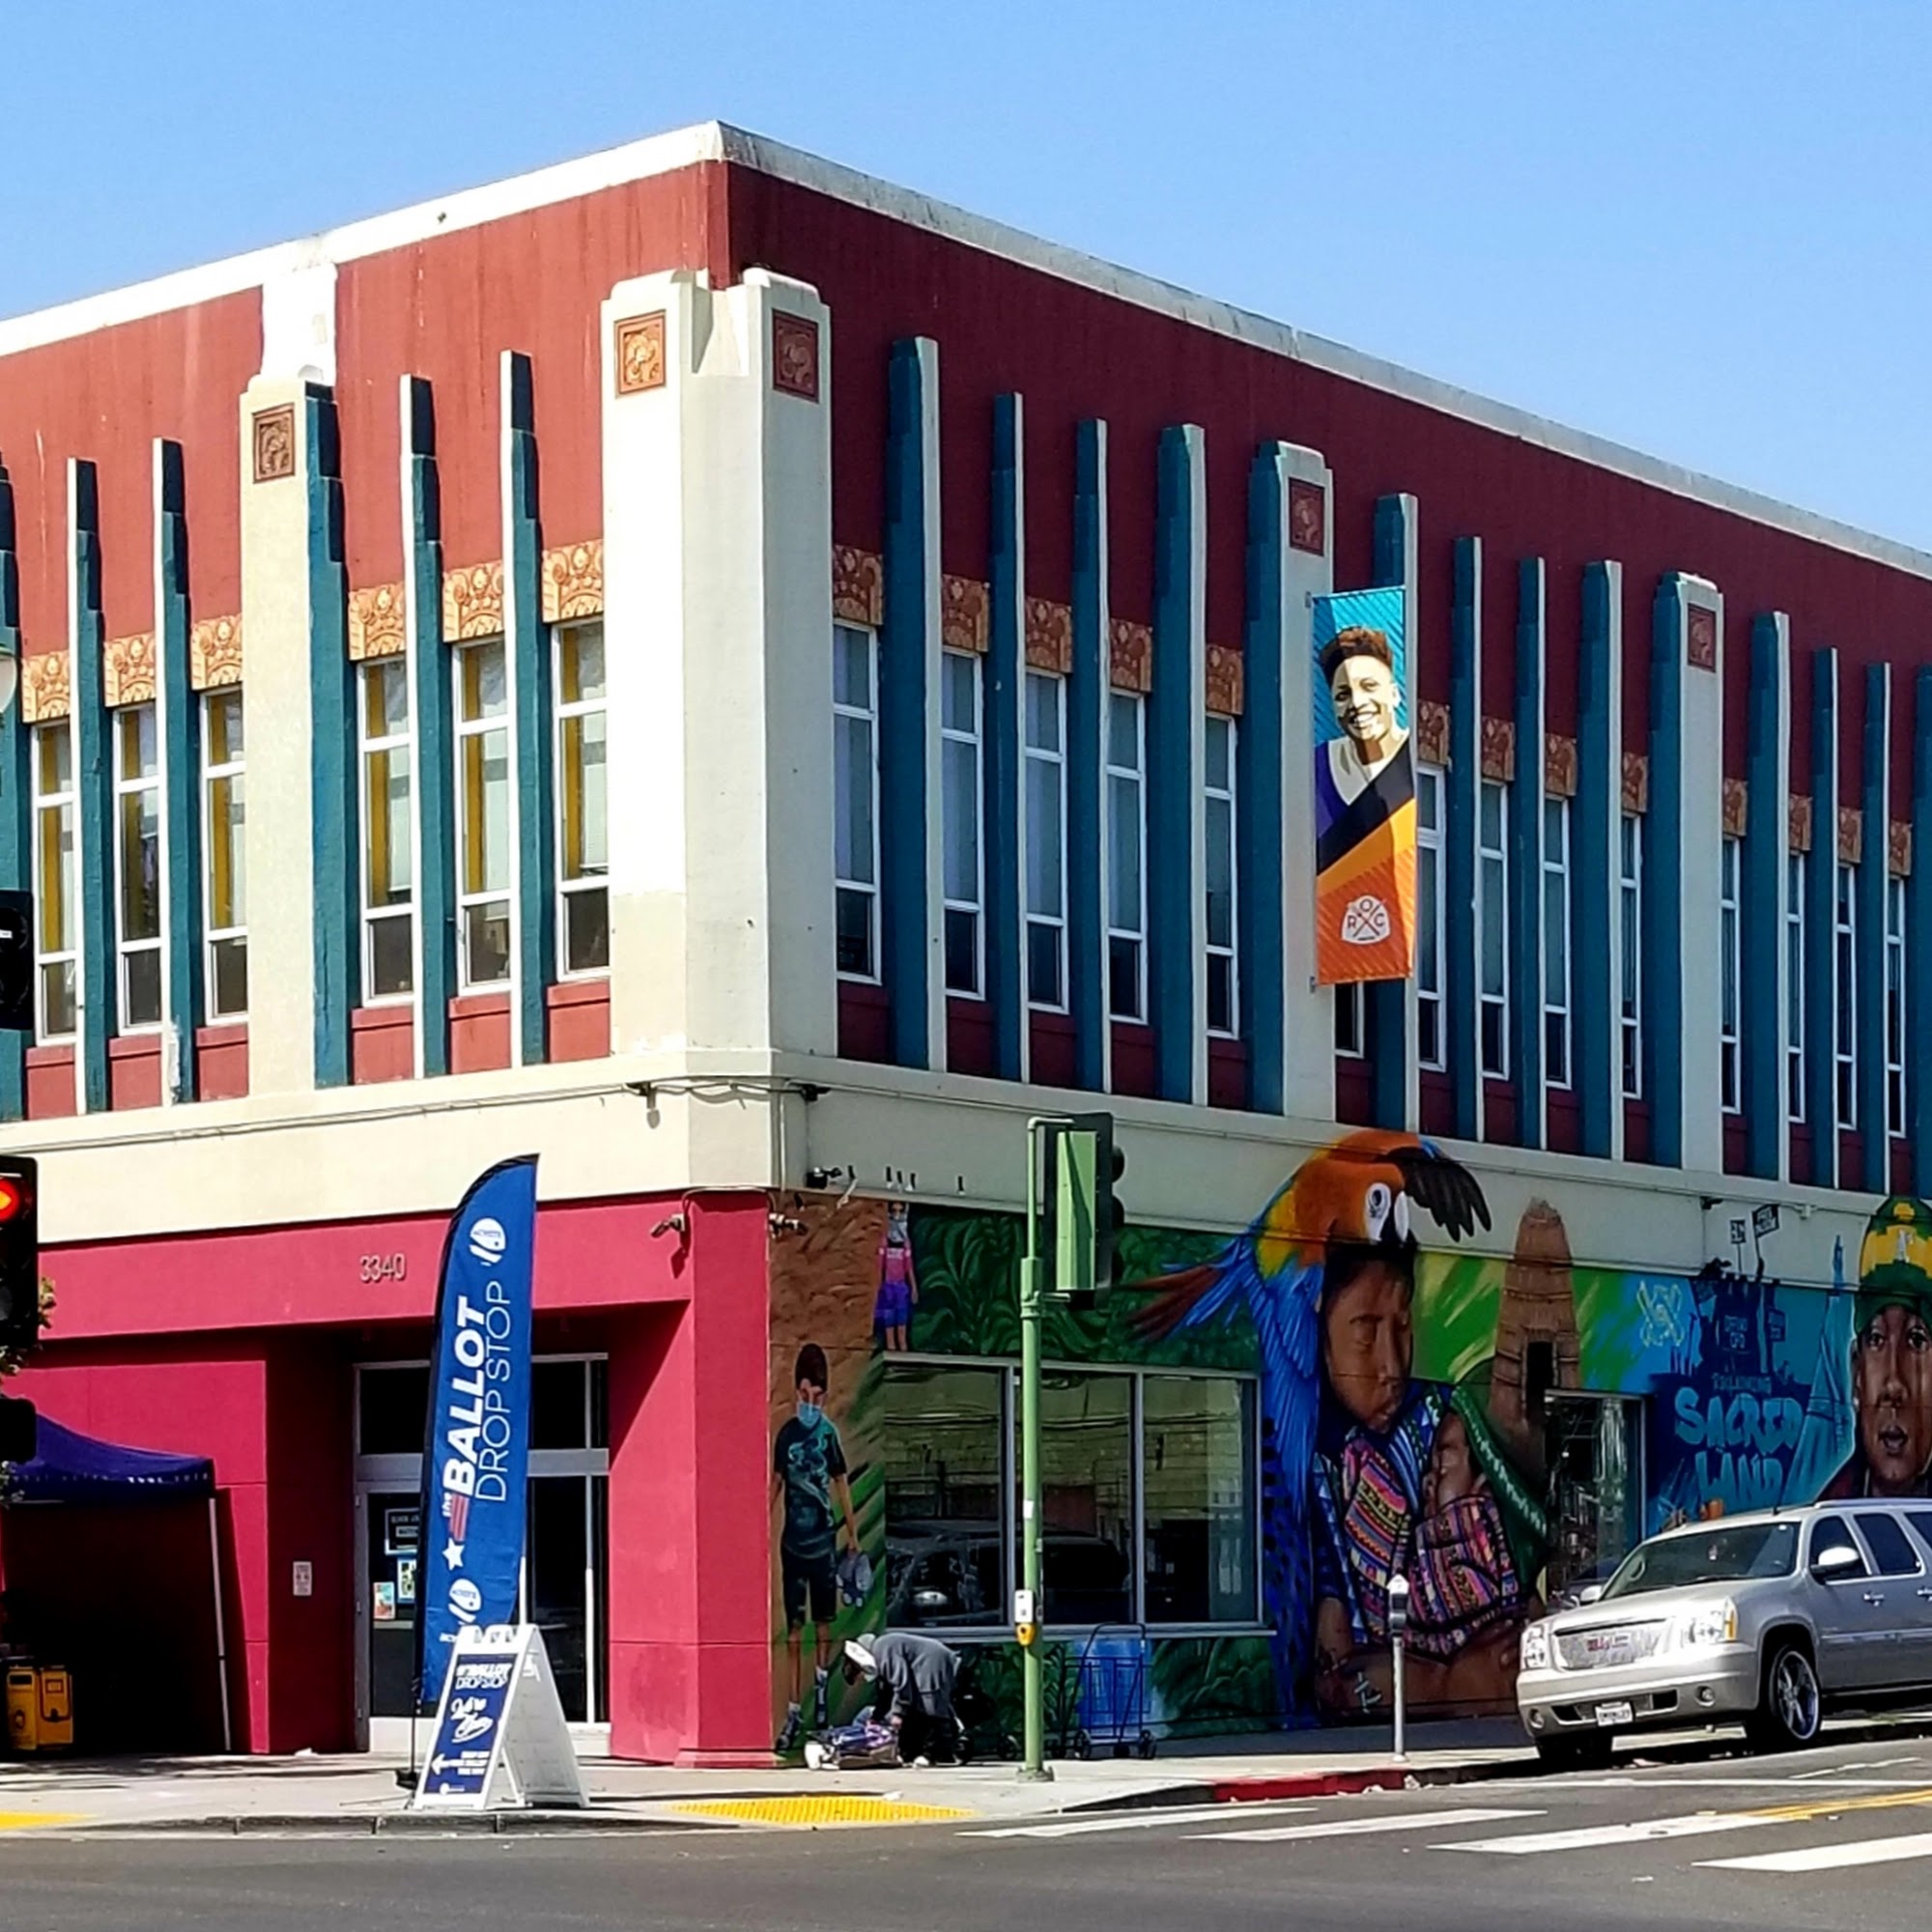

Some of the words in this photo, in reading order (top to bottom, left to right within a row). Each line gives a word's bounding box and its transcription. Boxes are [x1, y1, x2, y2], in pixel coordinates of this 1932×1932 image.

[359, 1254, 405, 1281] 3340
[486, 1281, 511, 1381] STOP
[443, 1295, 484, 1495] BALLOT
[1674, 1386, 1804, 1456] SACRED
[474, 1390, 511, 1501] DROP
[1695, 1450, 1782, 1502] LAND
